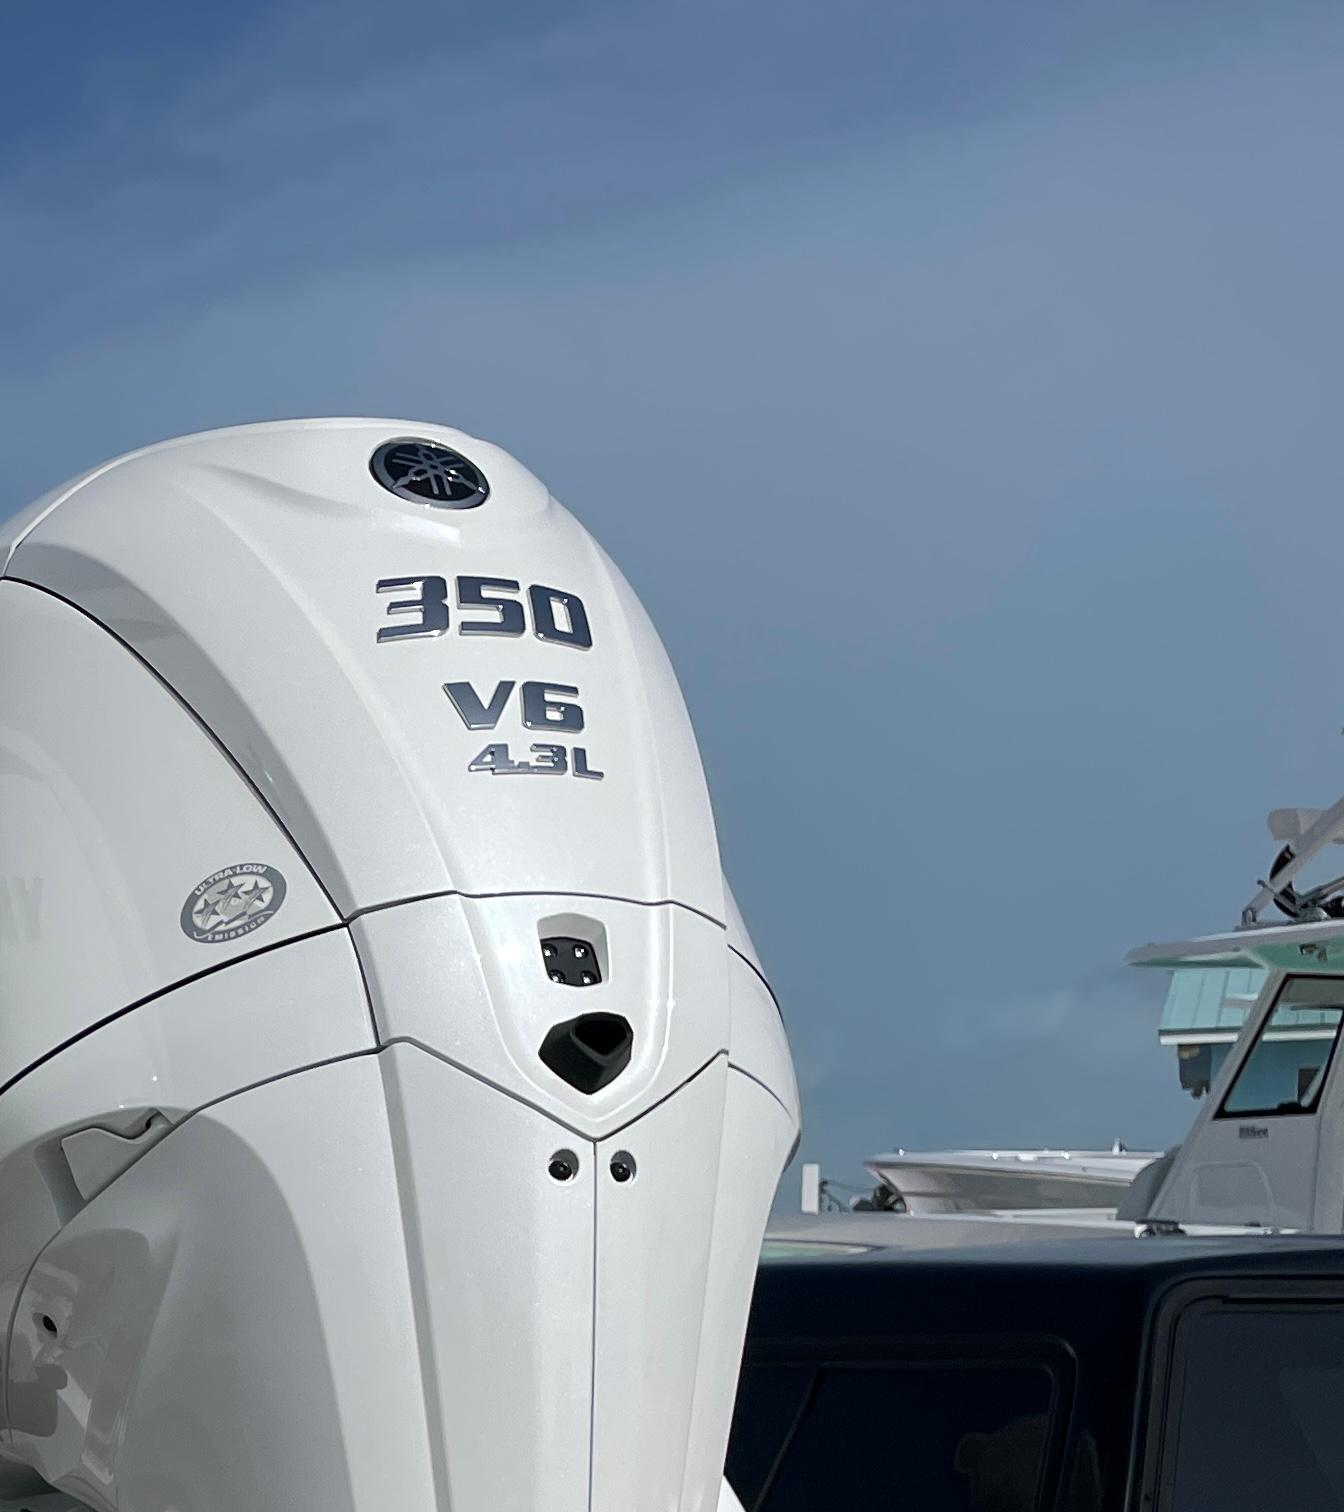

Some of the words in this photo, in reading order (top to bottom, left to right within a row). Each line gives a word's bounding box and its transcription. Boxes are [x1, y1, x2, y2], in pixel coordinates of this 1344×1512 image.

[376, 575, 593, 651] 350
[442, 680, 585, 734] V6
[468, 743, 605, 781] 4.3L
